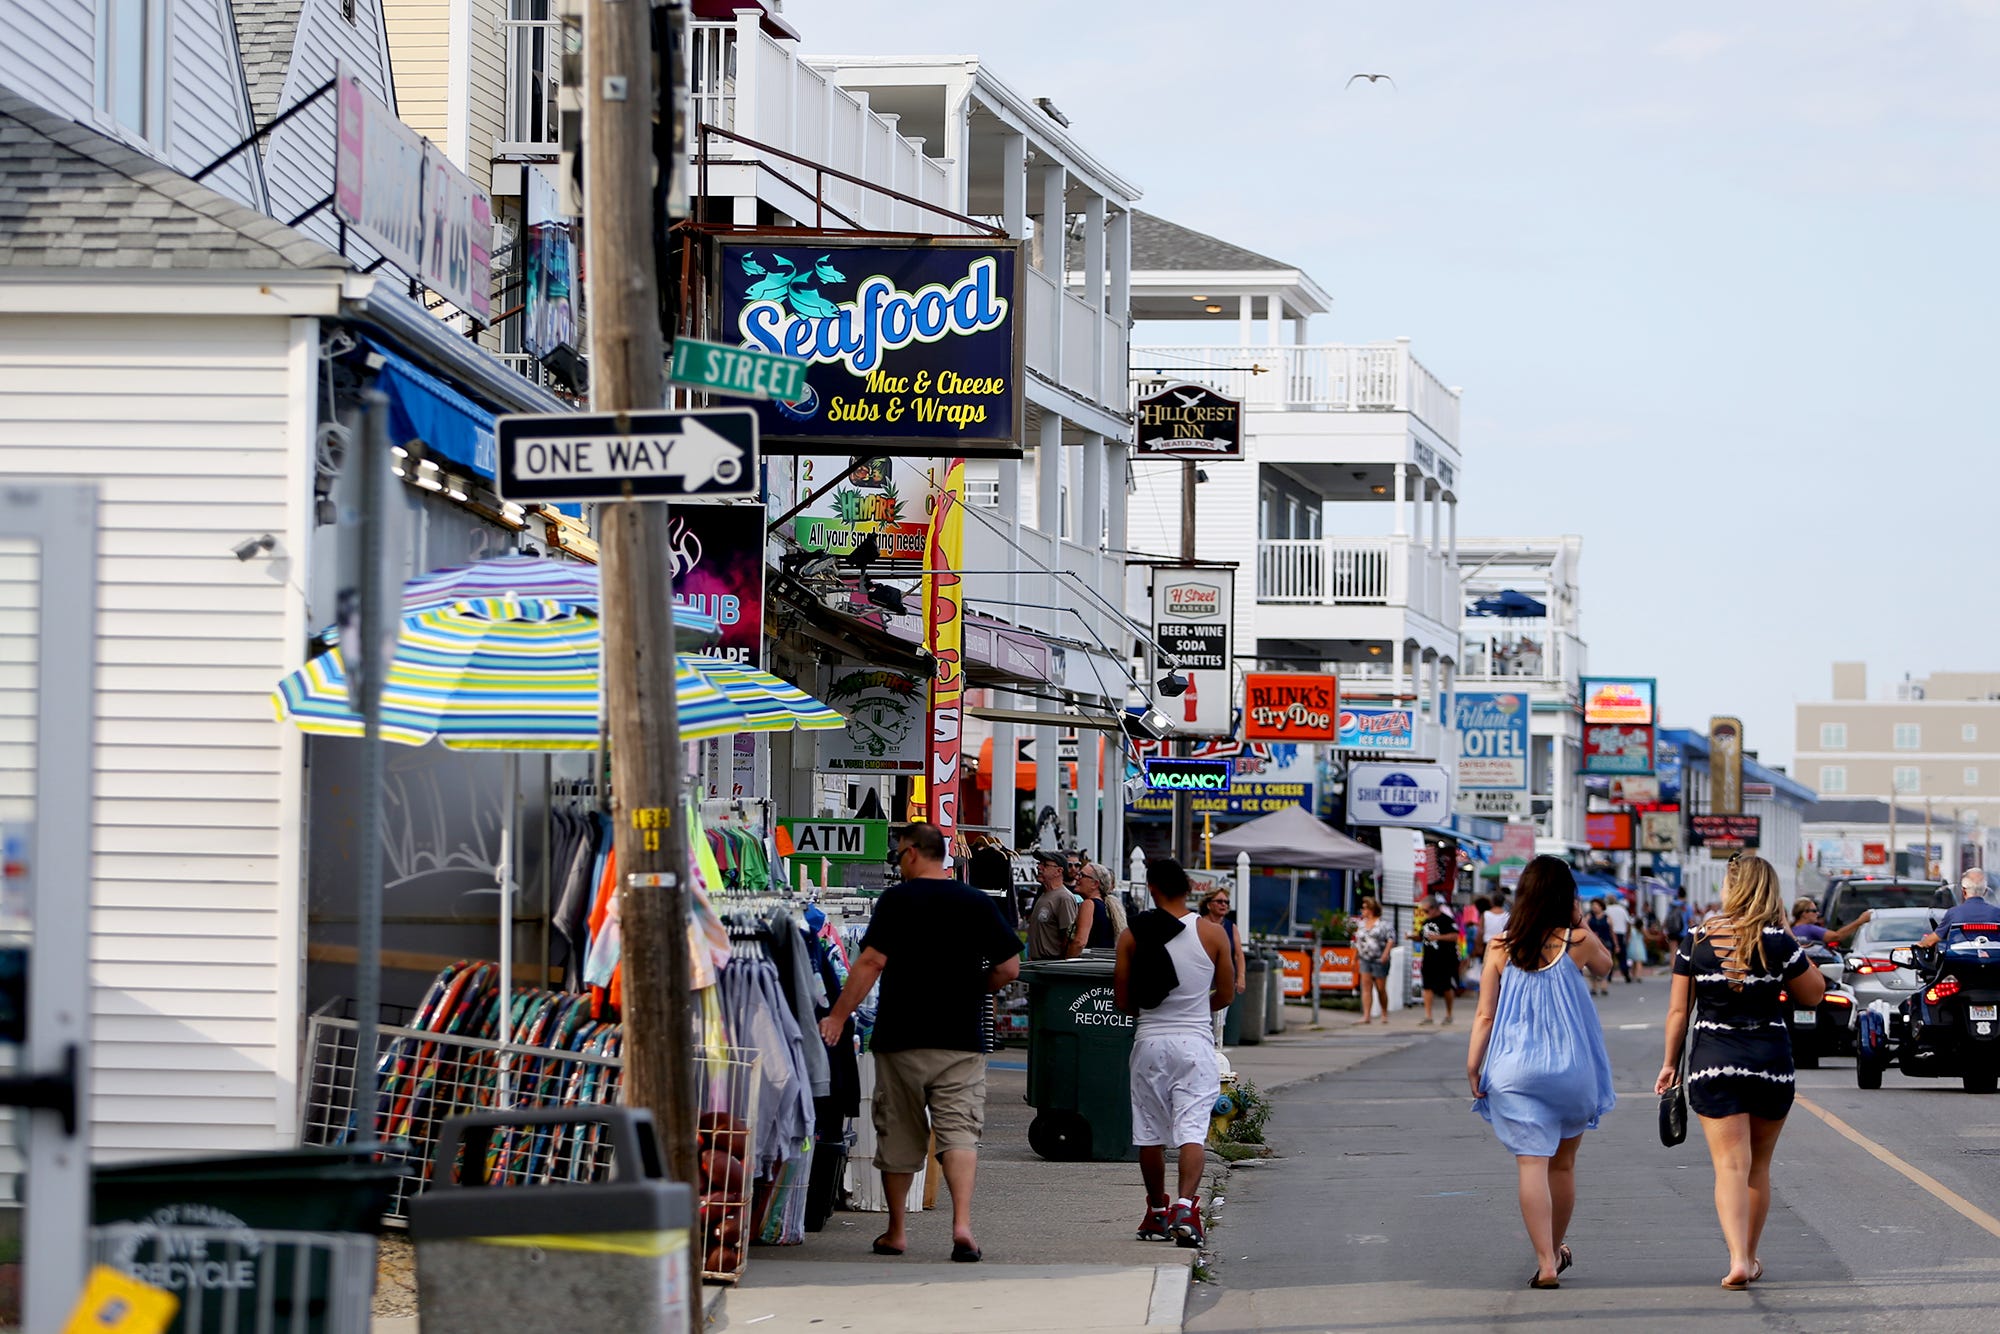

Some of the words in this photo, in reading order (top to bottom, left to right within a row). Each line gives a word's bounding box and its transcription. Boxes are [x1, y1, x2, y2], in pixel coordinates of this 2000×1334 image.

[742, 260, 1004, 373] Seafood
[704, 350, 800, 397] STREET
[864, 370, 909, 394] Mac
[913, 370, 932, 395] &
[937, 370, 1005, 395] Cheese
[828, 396, 881, 422] Subs
[886, 397, 905, 422] &
[910, 397, 987, 431] Wraps
[1172, 424, 1206, 438] INN
[1160, 441, 1192, 449] HEATED
[1194, 441, 1216, 449] POOL
[526, 443, 593, 474] ONE
[606, 440, 675, 472] WAY
[808, 523, 825, 546] All
[826, 528, 848, 552] your
[851, 528, 895, 555] sming
[896, 529, 926, 552] needs
[1170, 589, 1183, 603] H
[1184, 588, 1216, 603] Street
[1172, 605, 1213, 613] MARKET
[1160, 625, 1188, 637] BEER
[1193, 626, 1224, 638] WINE
[1176, 640, 1207, 651] SODA
[1164, 654, 1222, 667] CARETTES
[1252, 686, 1329, 709] BLINK'S
[1251, 706, 1290, 730] Fry
[1289, 702, 1330, 730] Doe
[1358, 711, 1410, 733] PIZZA
[1359, 735, 1374, 745] ICE
[1376, 736, 1409, 746] CREAM
[1457, 729, 1525, 757] OTEL
[1062, 747, 1079, 755] WA
[1235, 757, 1266, 774] ETC
[1149, 772, 1226, 788] VACANCY
[1358, 787, 1388, 802] SHIRT
[1392, 788, 1440, 804] FACTORY
[797, 825, 861, 852] ATM
[1069, 991, 1091, 1013] TOWN
[1090, 987, 1103, 997] OF
[1093, 999, 1114, 1012] WE
[1075, 1012, 1134, 1028] RECYCLE
